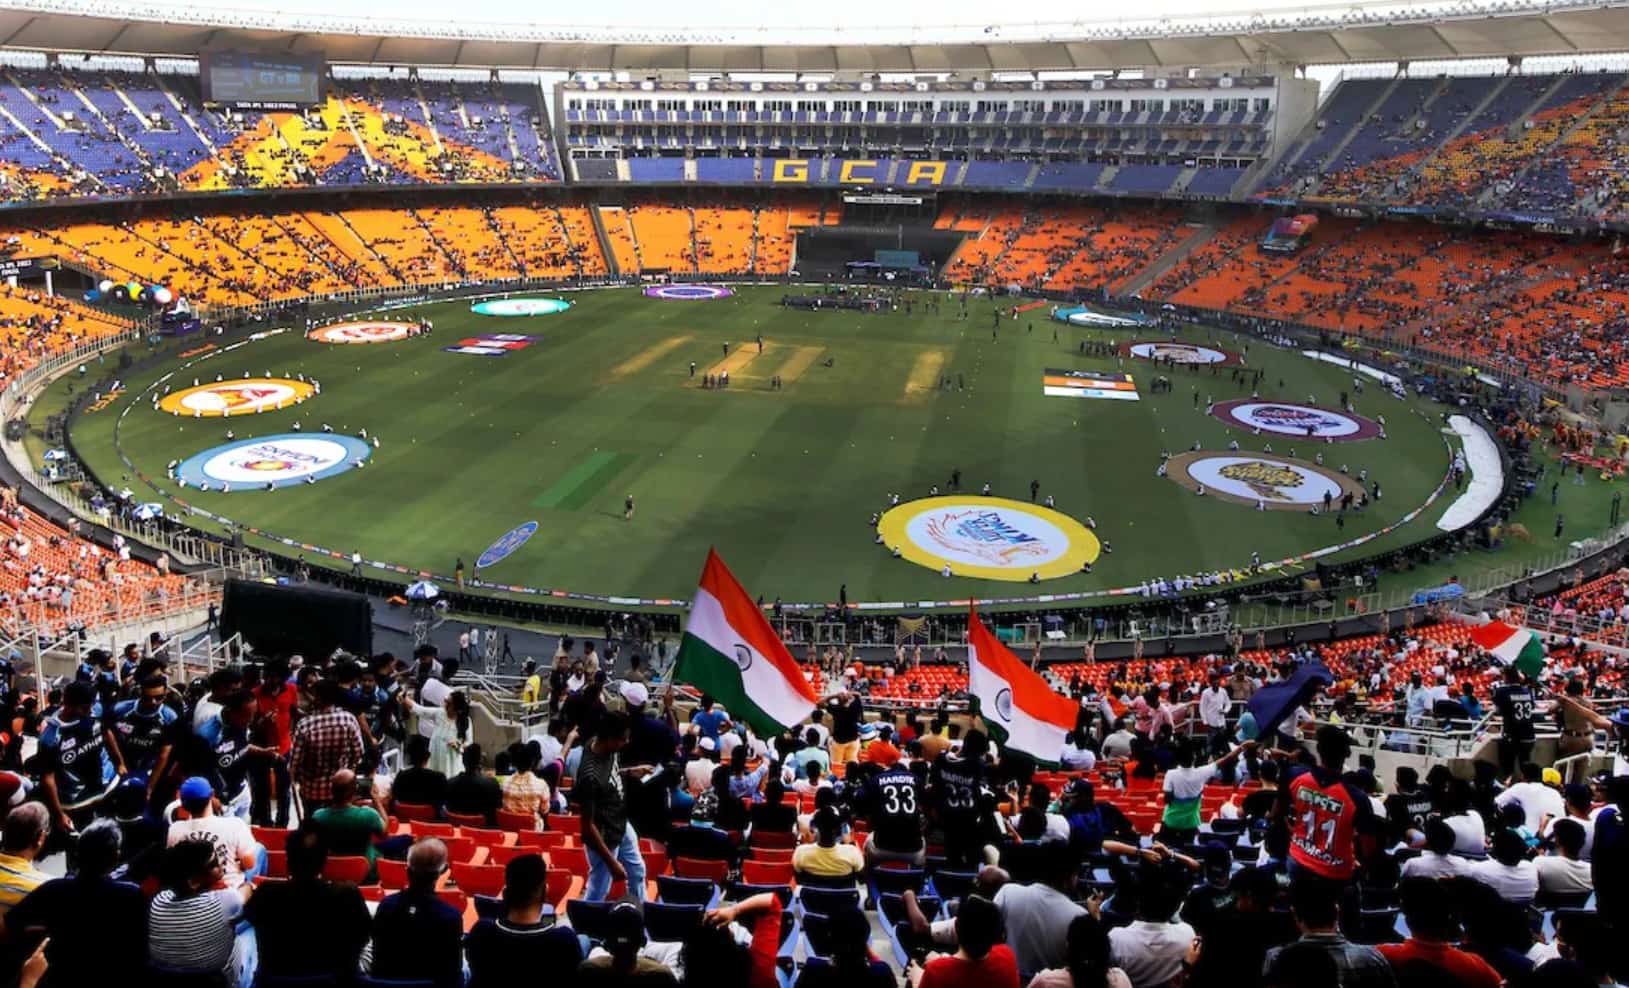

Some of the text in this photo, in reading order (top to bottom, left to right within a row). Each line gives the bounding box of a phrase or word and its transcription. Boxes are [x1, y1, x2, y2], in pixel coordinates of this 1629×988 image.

[773, 159, 948, 184] GCA
[1514, 702, 1532, 720] 33
[879, 775, 916, 785] HARDIK
[883, 785, 916, 814] 33
[1302, 810, 1336, 850] 11
